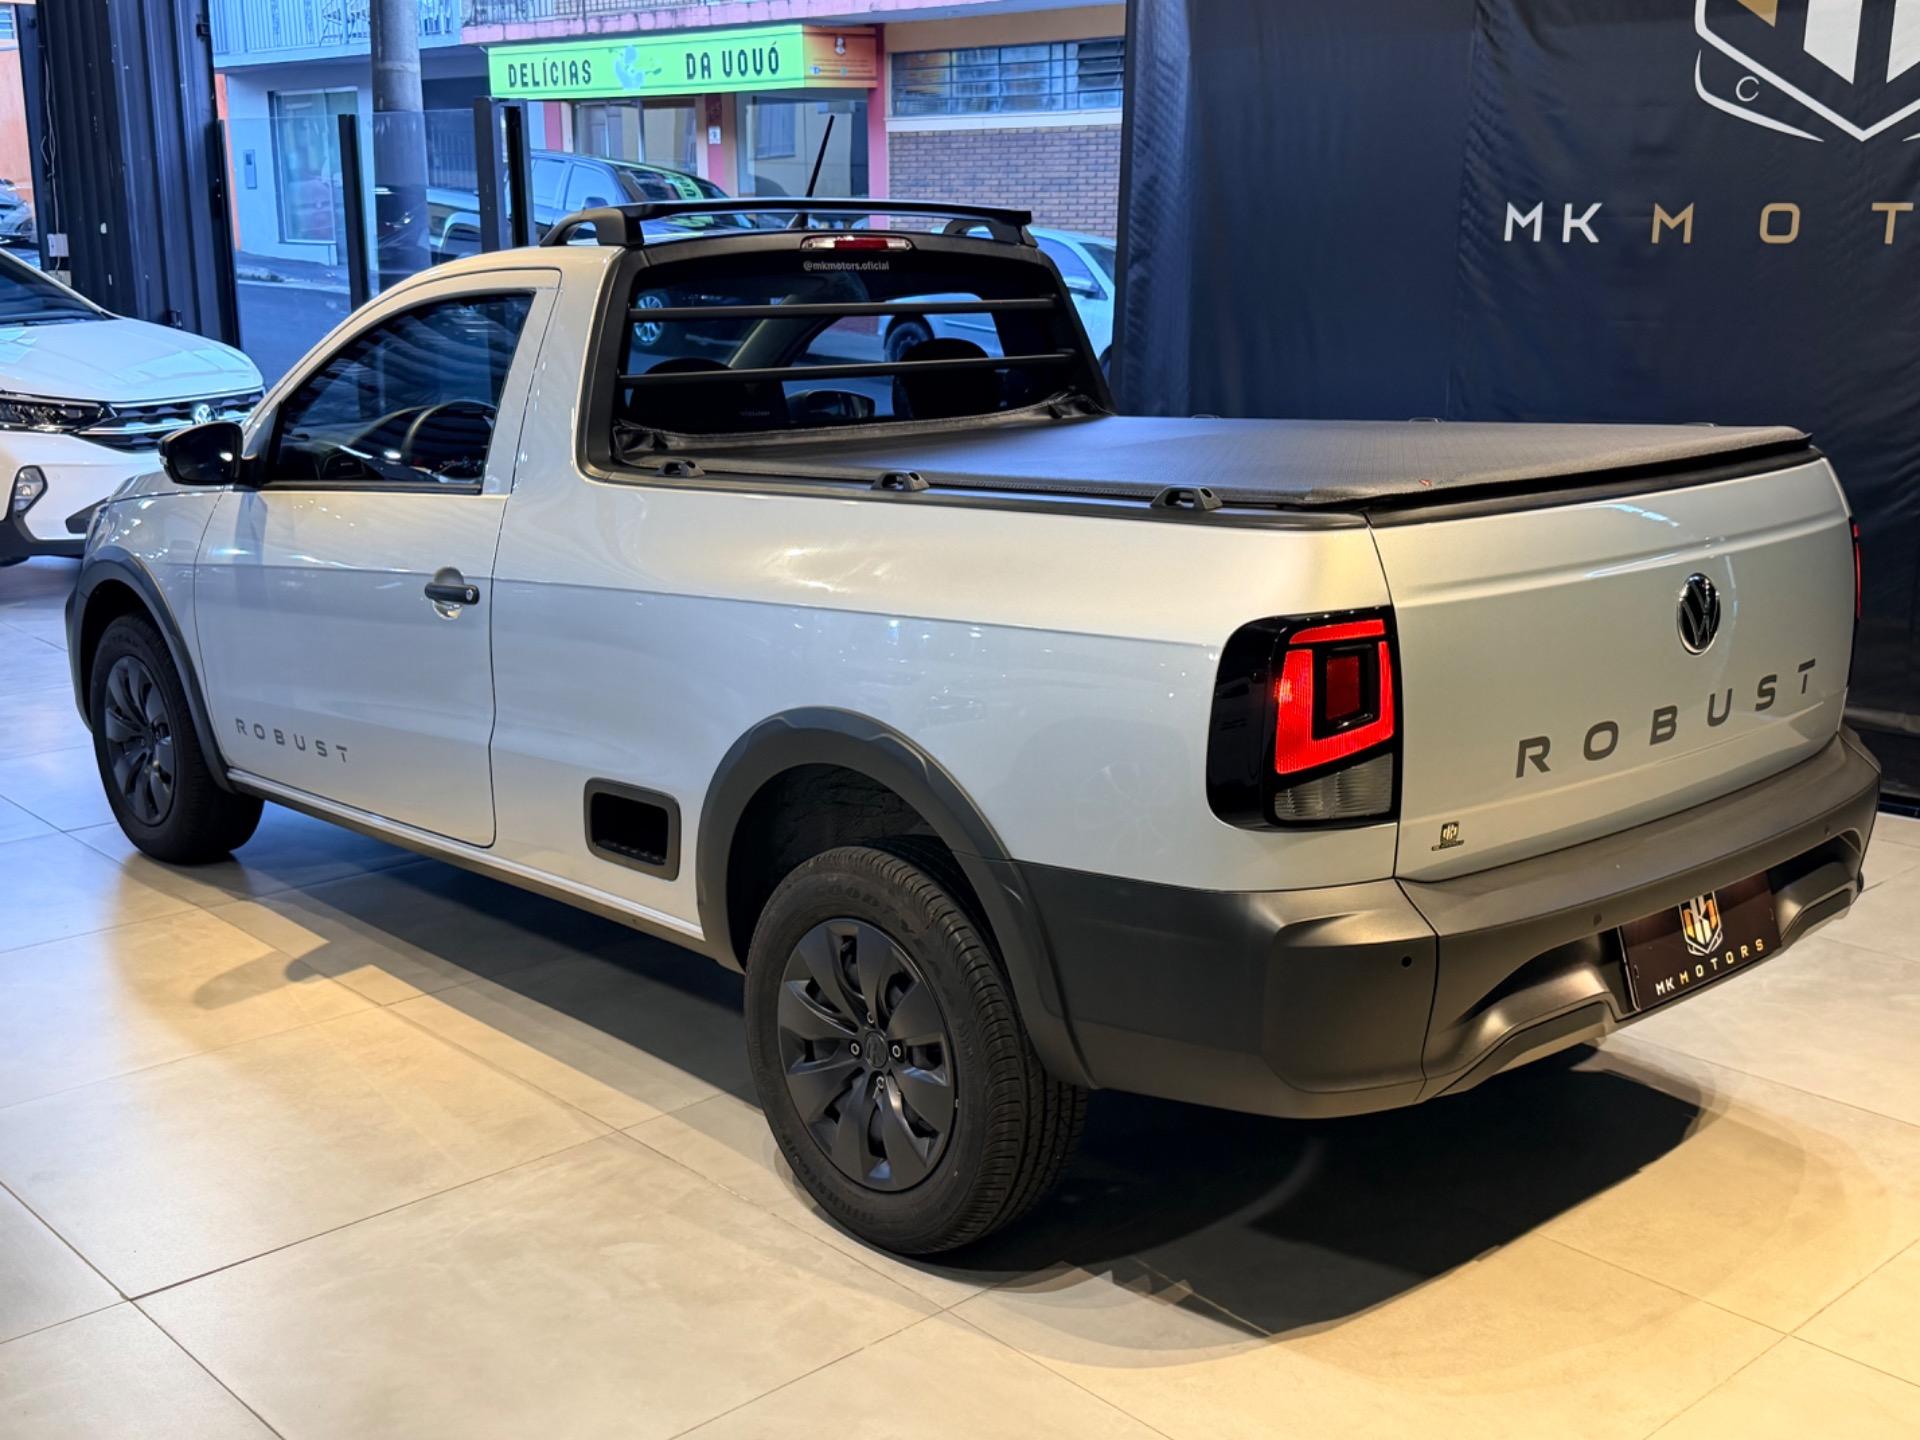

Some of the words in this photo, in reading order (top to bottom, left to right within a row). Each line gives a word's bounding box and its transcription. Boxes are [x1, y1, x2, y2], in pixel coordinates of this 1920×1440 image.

[508, 57, 592, 88] DELÍCIAS
[686, 52, 711, 80] DA
[803, 260, 889, 272] @mkmotors.oficial
[1515, 658, 1816, 778] ROBUST
[235, 718, 349, 763] ROBUST
